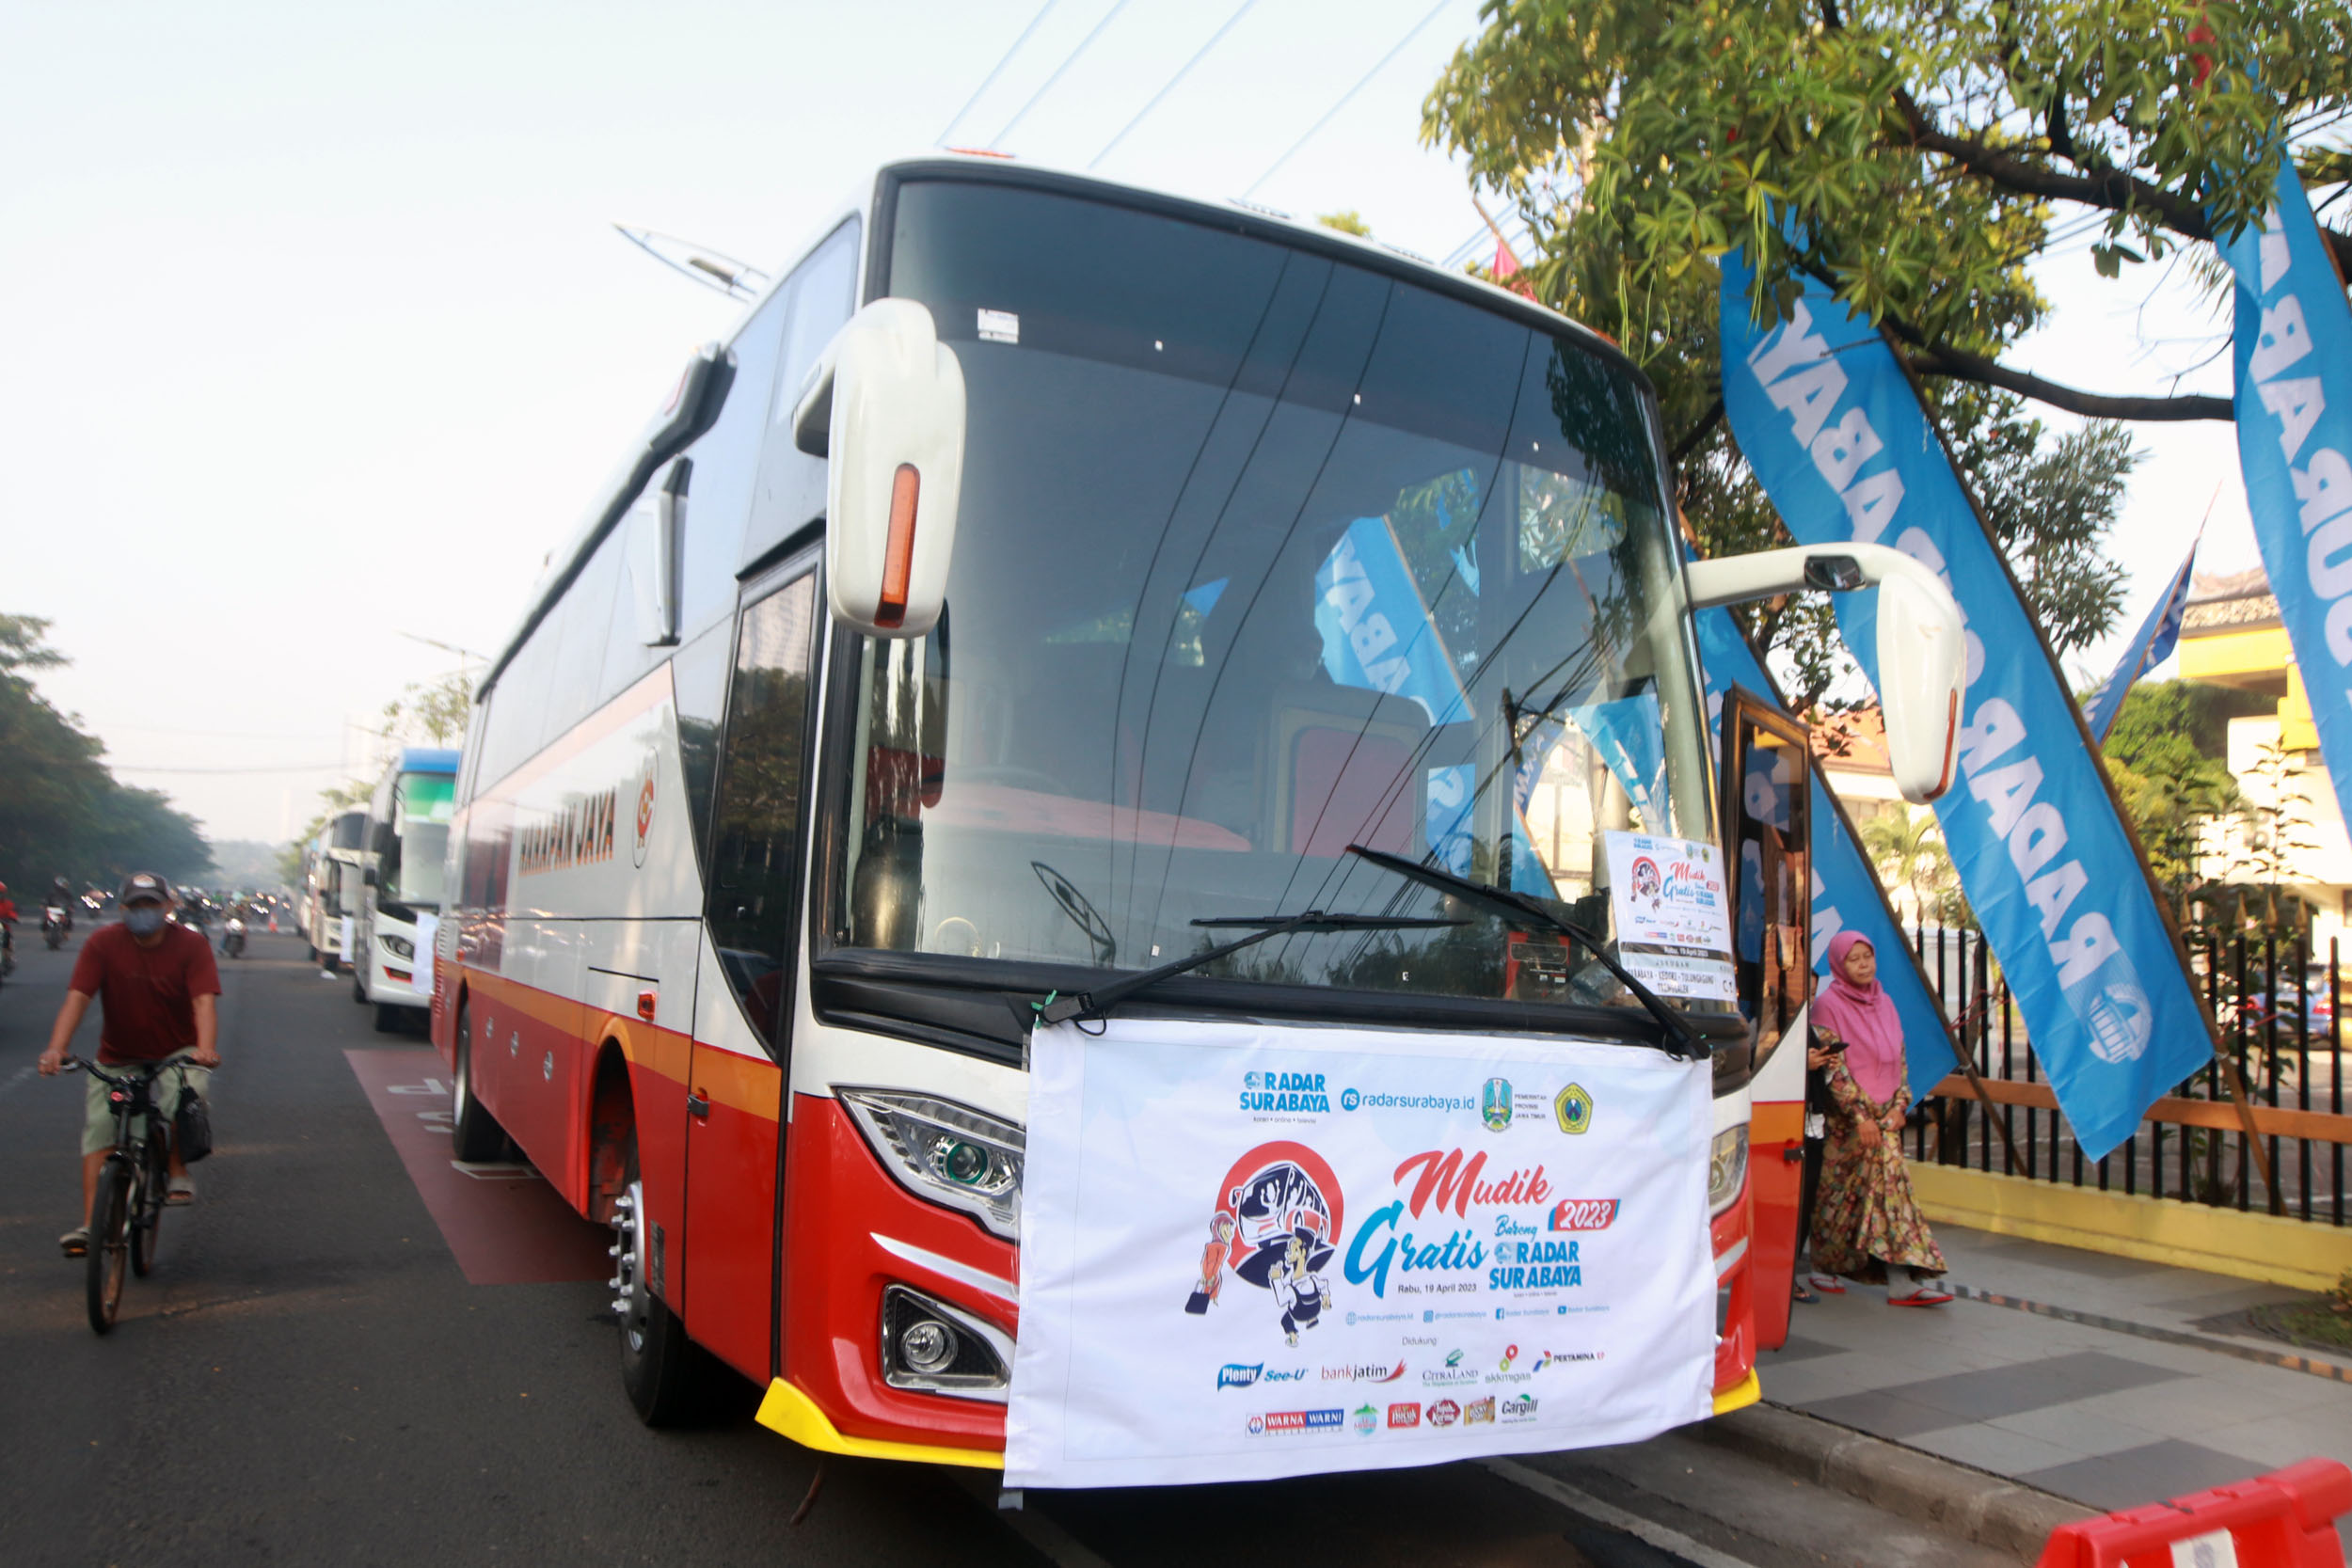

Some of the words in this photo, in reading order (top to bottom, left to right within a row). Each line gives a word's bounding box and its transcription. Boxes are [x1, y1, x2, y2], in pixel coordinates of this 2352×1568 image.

[576, 786, 615, 865] JAYA
[1264, 1071, 1326, 1092] RADAR
[1240, 1091, 1330, 1113] SURABAYA
[1362, 1093, 1475, 1113] radarsurabaya.id
[1393, 1148, 1553, 1220] Mudik
[1559, 1201, 1613, 1229] 2023
[1343, 1199, 1489, 1299] Gratis
[1517, 1241, 1580, 1264] RADAR
[1489, 1265, 1581, 1291] SURABAYA
[1398, 1284, 1422, 1294] Rabu,
[1425, 1285, 1434, 1293] 19
[1437, 1284, 1455, 1294] April
[1458, 1283, 1477, 1292] 2023
[1402, 1336, 1438, 1346] Didukung
[1553, 1353, 1595, 1363] PERTAMINA
[1222, 1367, 1259, 1383] Plenty
[1264, 1369, 1306, 1382] See-U
[1321, 1364, 1388, 1382] bankjatim
[1502, 1400, 1538, 1417] Cargill
[1267, 1414, 1304, 1427] WARNA
[1309, 1412, 1342, 1424] WARNI
